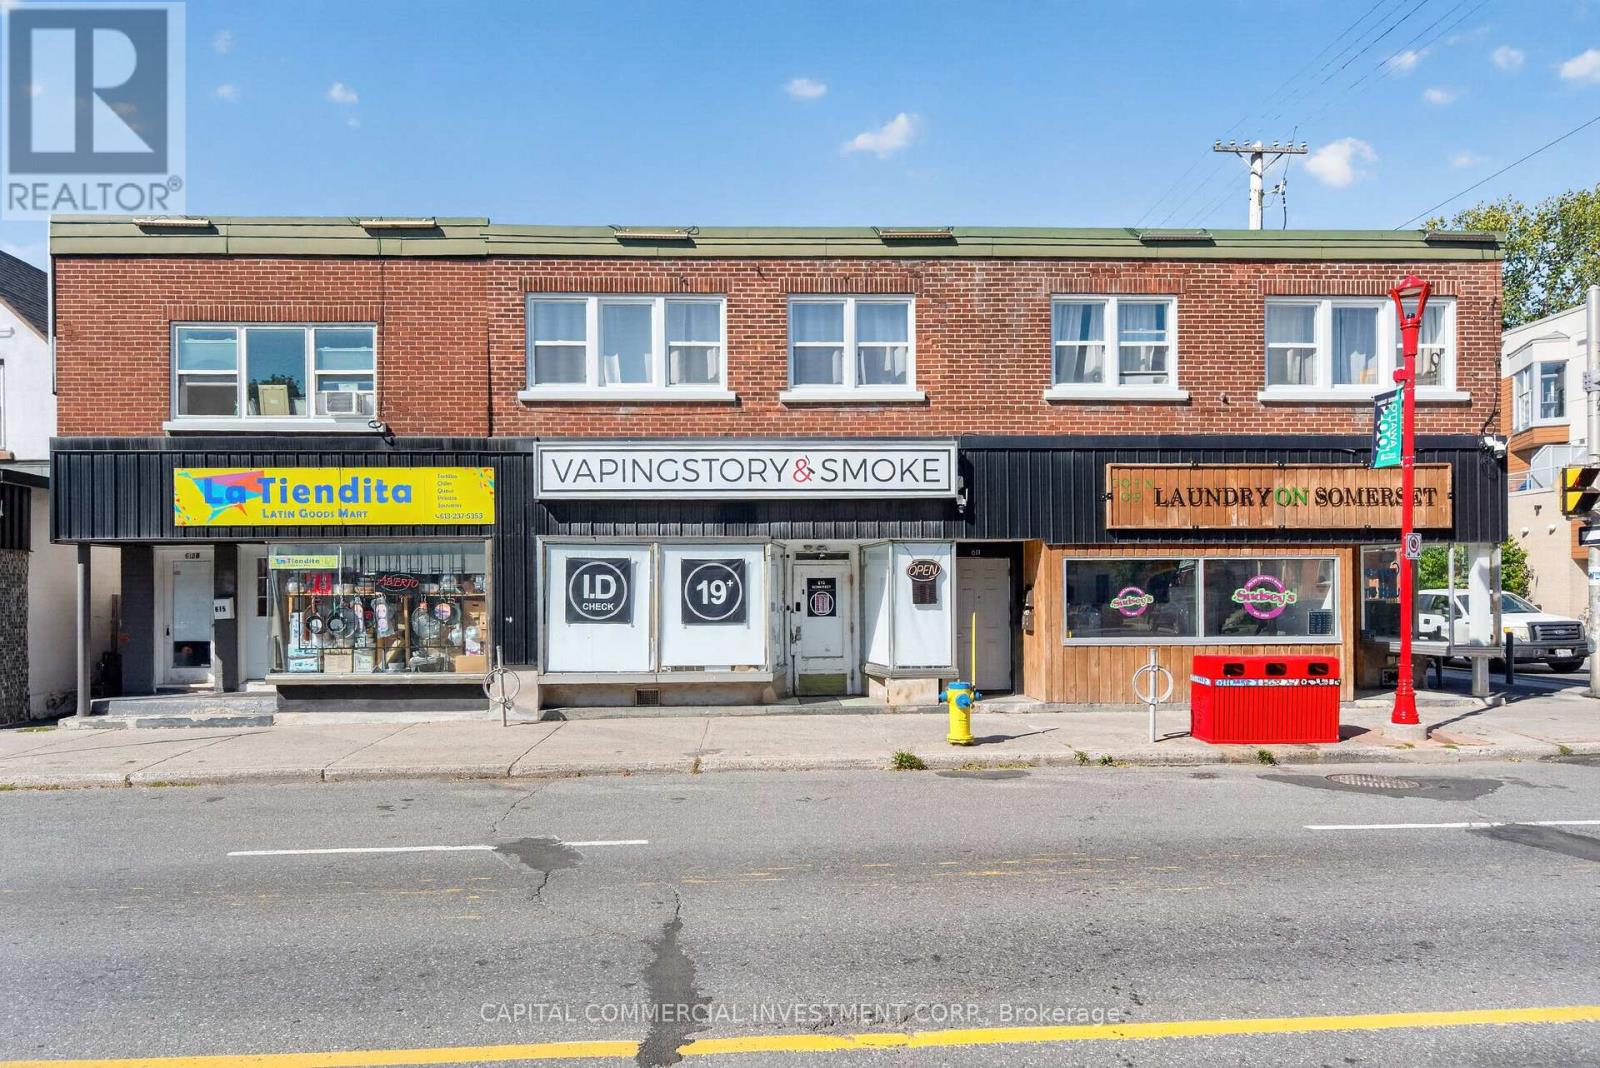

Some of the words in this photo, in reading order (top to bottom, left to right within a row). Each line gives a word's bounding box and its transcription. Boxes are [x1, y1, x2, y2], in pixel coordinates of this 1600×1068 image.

[204, 477, 247, 504] La
[256, 476, 412, 504] Tiendita
[1154, 487, 1273, 507] LAUNDRY
[1274, 487, 1310, 507] ON
[1315, 487, 1437, 507] SOMERSET
[908, 564, 938, 576] OPEN
[377, 575, 419, 588] ABIERTO
[583, 574, 617, 599] I.D
[582, 602, 615, 611] CHECK
